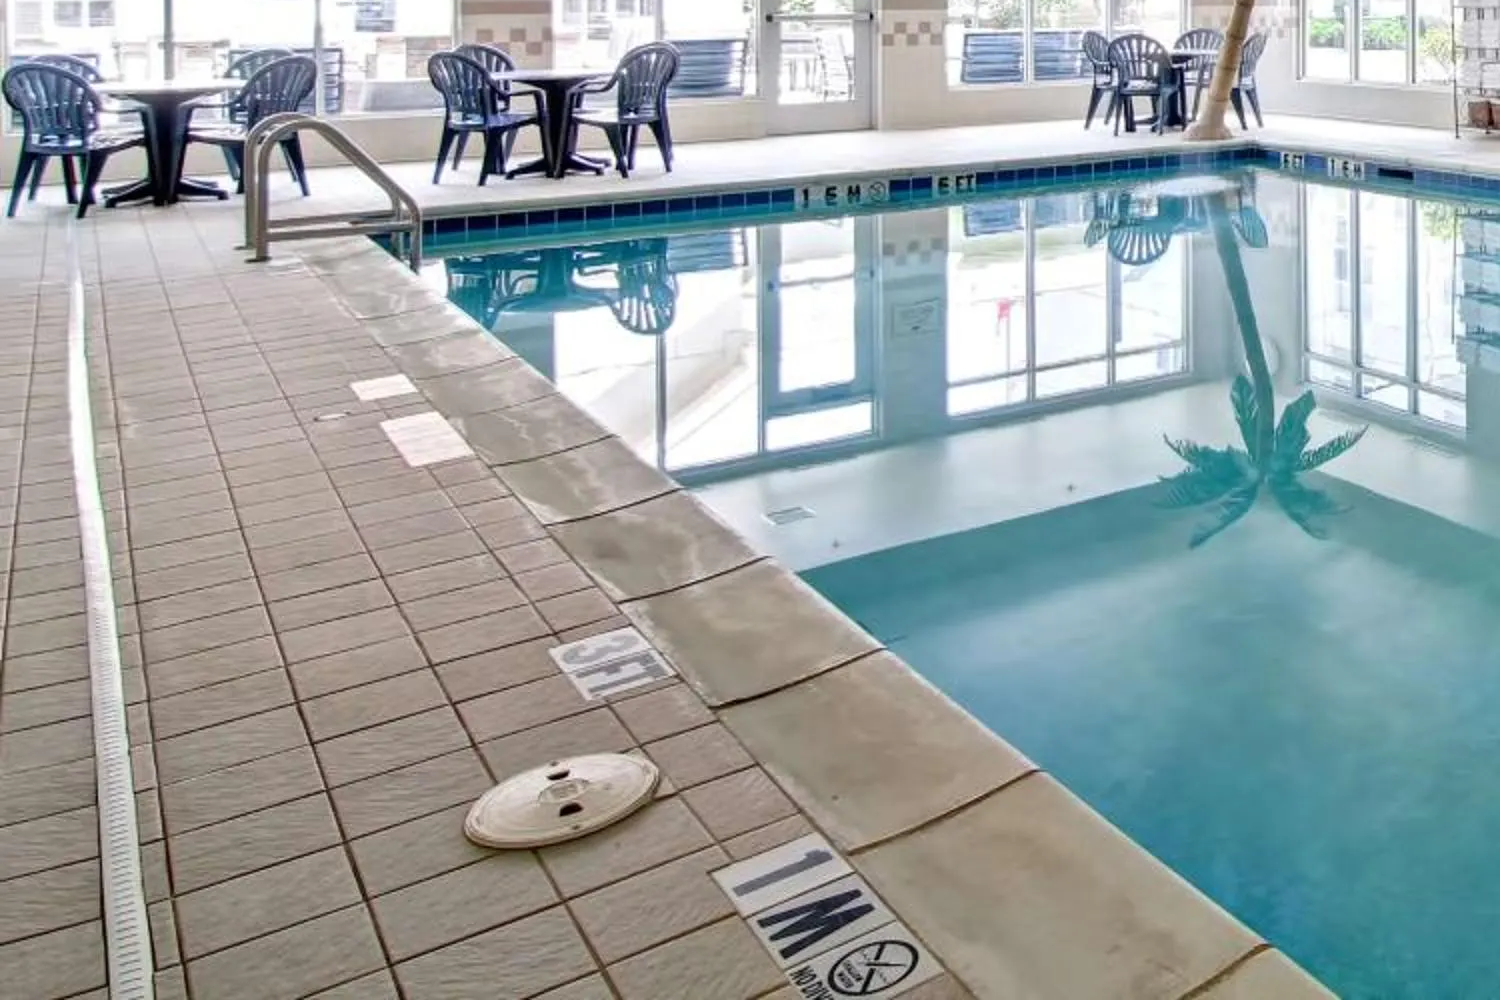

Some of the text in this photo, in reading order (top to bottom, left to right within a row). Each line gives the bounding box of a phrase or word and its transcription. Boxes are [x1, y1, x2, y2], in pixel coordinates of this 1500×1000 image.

[575, 652, 666, 693] FT
[732, 849, 876, 960] 1 M
